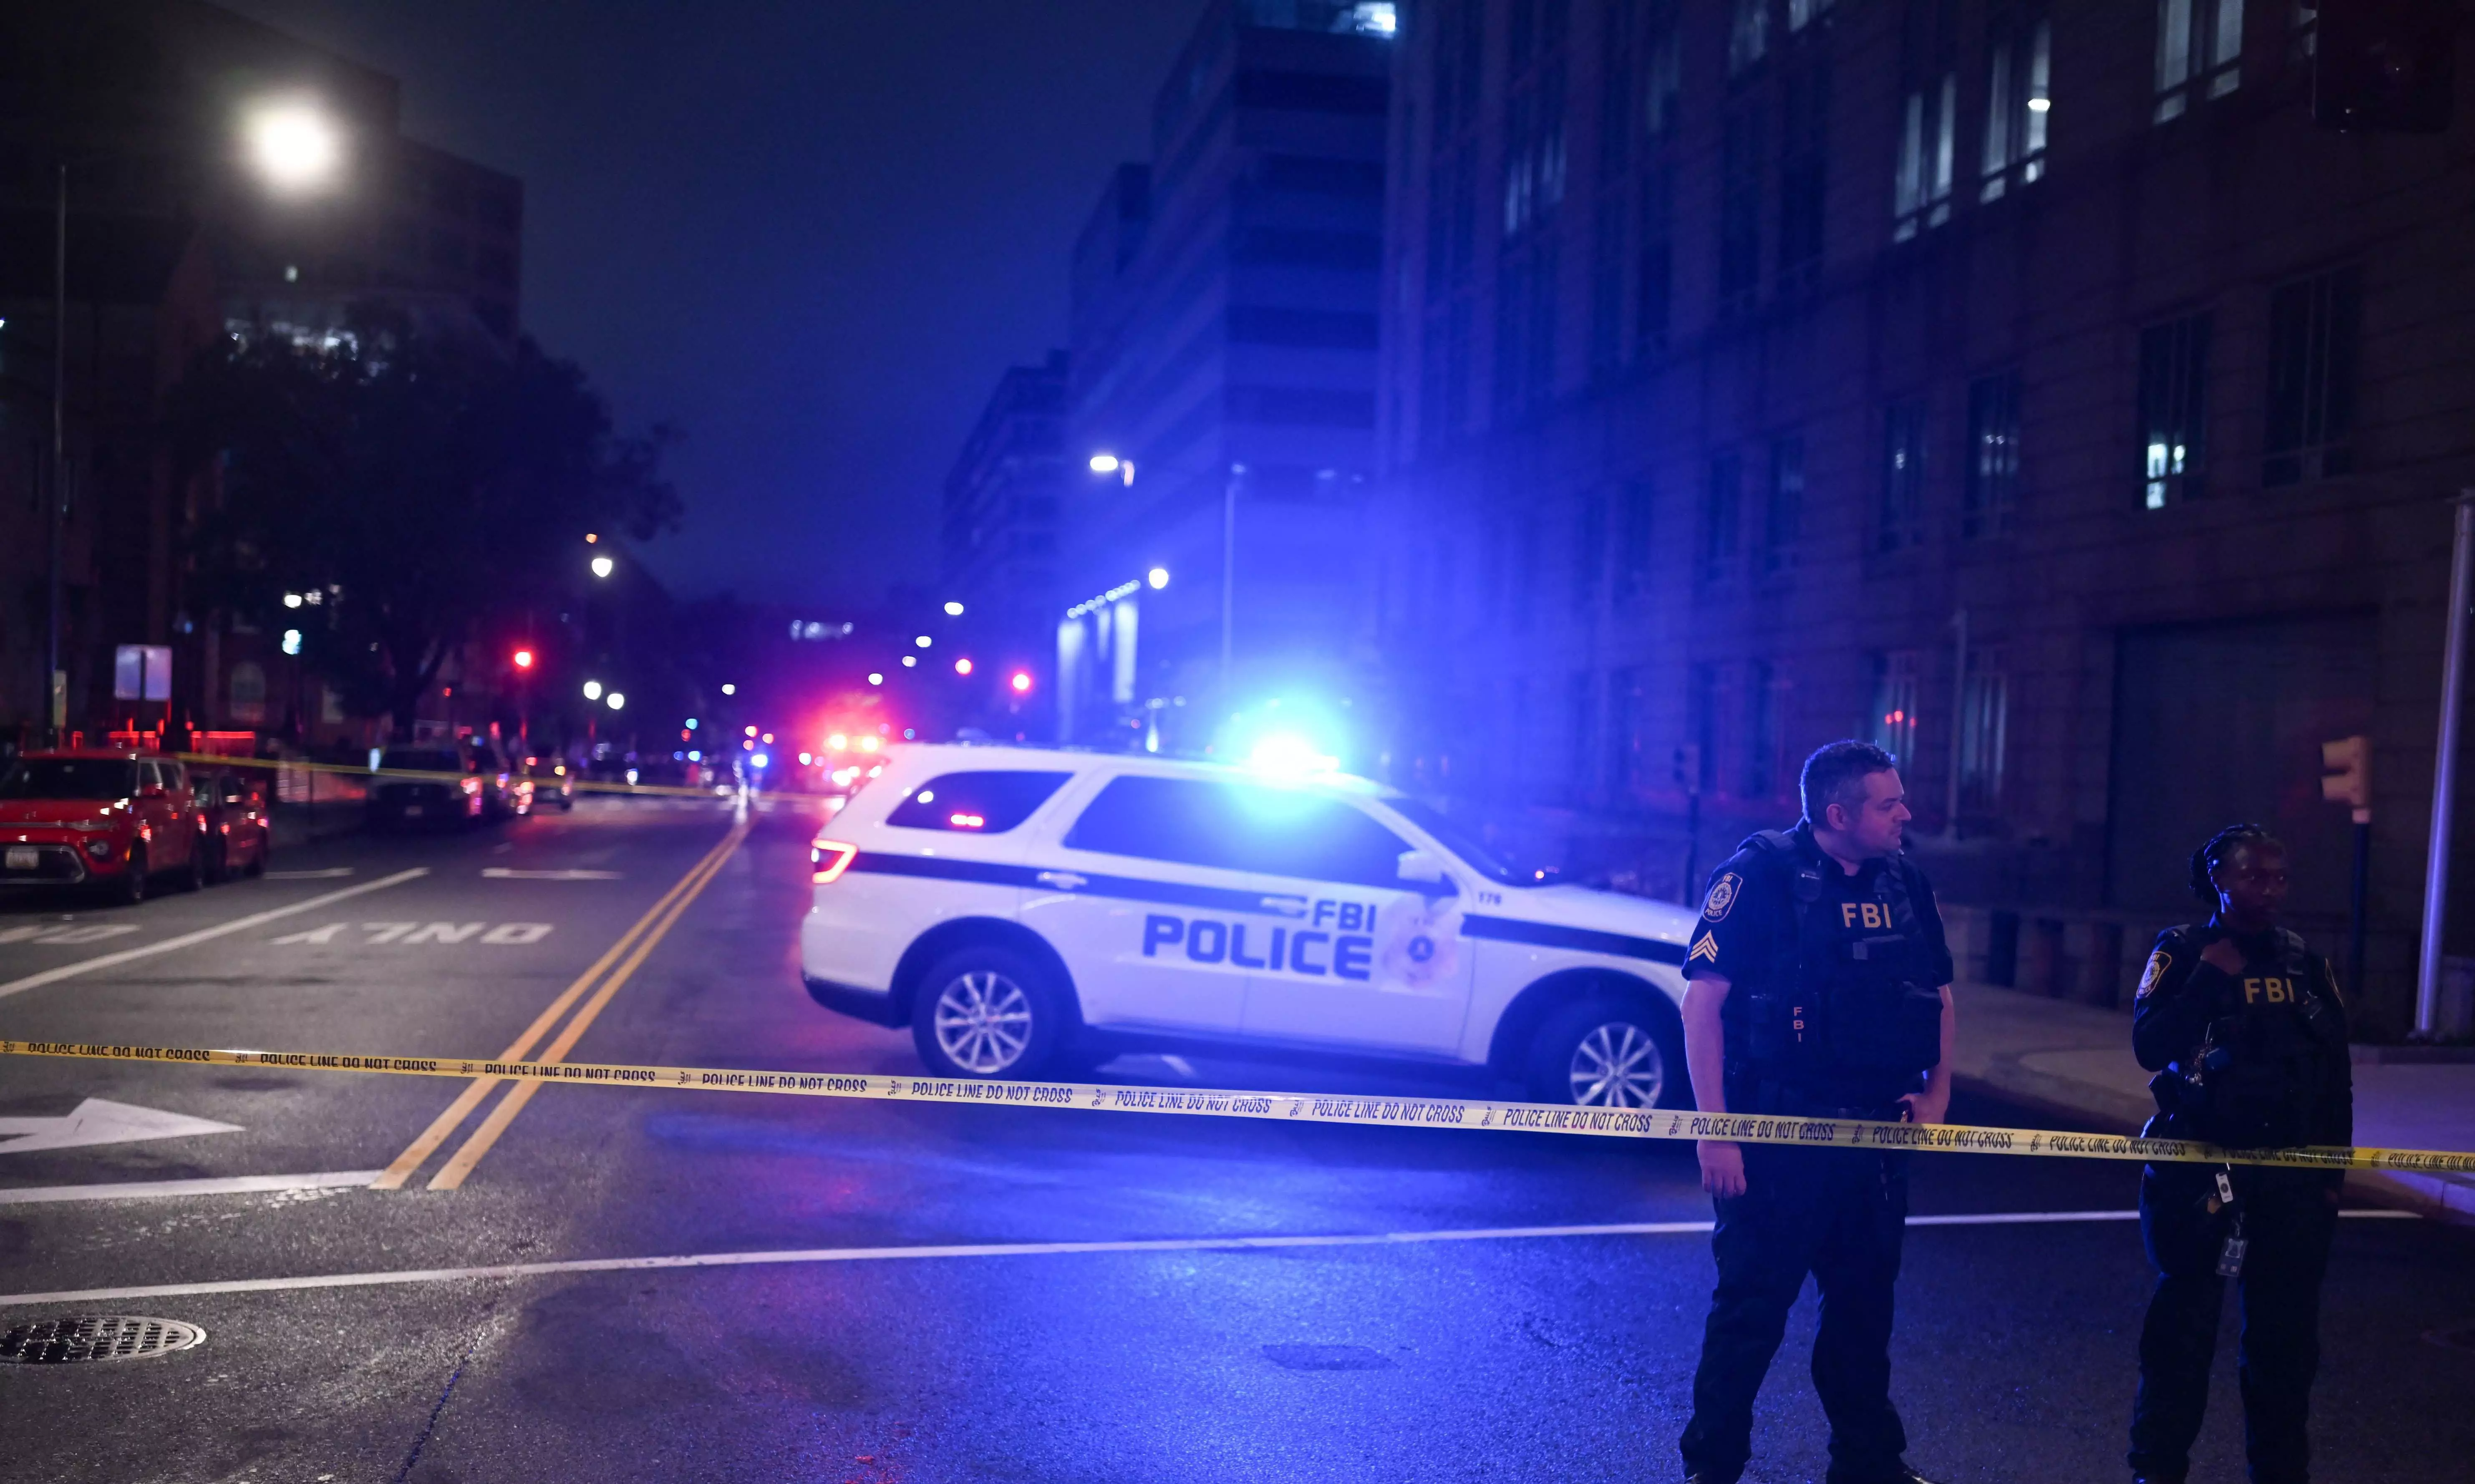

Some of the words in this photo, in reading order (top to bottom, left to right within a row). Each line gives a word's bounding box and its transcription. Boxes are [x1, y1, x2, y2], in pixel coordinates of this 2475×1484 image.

[1313, 899, 1376, 933] FBI
[1704, 908, 1722, 917] POLICE
[1841, 903, 1891, 928] FBI
[1142, 914, 1373, 981] POLICE
[2243, 978, 2294, 1004] FBI
[1793, 1006, 1805, 1042] FBI
[260, 1054, 306, 1065] POLICE
[310, 1055, 338, 1066] LINE
[343, 1057, 360, 1068] DO
[365, 1058, 391, 1069] NOT
[394, 1059, 437, 1072] CROSS
[485, 1064, 529, 1075] POLICE
[533, 1066, 560, 1077] LINE
[565, 1067, 581, 1078] DO
[586, 1068, 610, 1079] NOT
[614, 1070, 655, 1082] CROSS
[702, 1074, 744, 1086] POLICE
[748, 1076, 775, 1087] LINE
[779, 1077, 795, 1088] DO
[799, 1078, 824, 1090] NOT
[827, 1079, 867, 1092] CROSS
[912, 1082, 954, 1096] POLICE
[956, 1084, 983, 1098] LINE
[985, 1085, 1003, 1099] DO
[1006, 1086, 1031, 1101] NOT
[1032, 1087, 1073, 1103] CROSS
[1115, 1091, 1157, 1107] POLICE
[1158, 1093, 1185, 1108] LINE
[1186, 1094, 1205, 1109] DO
[1206, 1094, 1229, 1111] NOT
[1232, 1097, 1272, 1113] CROSS
[1312, 1099, 1354, 1117] POLICE
[1354, 1101, 1379, 1118] LINE
[1382, 1102, 1399, 1119] DO
[1400, 1103, 1425, 1121] NOT
[1426, 1104, 1464, 1123] CROSS
[1504, 1109, 1545, 1127] POLICE
[1545, 1110, 1571, 1127] LINE
[1571, 1111, 1589, 1129] DO
[1590, 1112, 1615, 1130] NOT
[1614, 1113, 1652, 1132] CROSS
[1690, 1118, 1731, 1135] POLICE
[1730, 1119, 1757, 1137] LINE
[1757, 1121, 1774, 1138] DO
[1775, 1122, 1800, 1139] NOT
[1799, 1122, 1835, 1141] CROSS
[1872, 1127, 1910, 1143] POLICE
[1912, 1128, 1937, 1145] LINE
[1937, 1129, 1954, 1146] DO
[1955, 1130, 1980, 1147] NOT
[1977, 1131, 2014, 1148] CROSS
